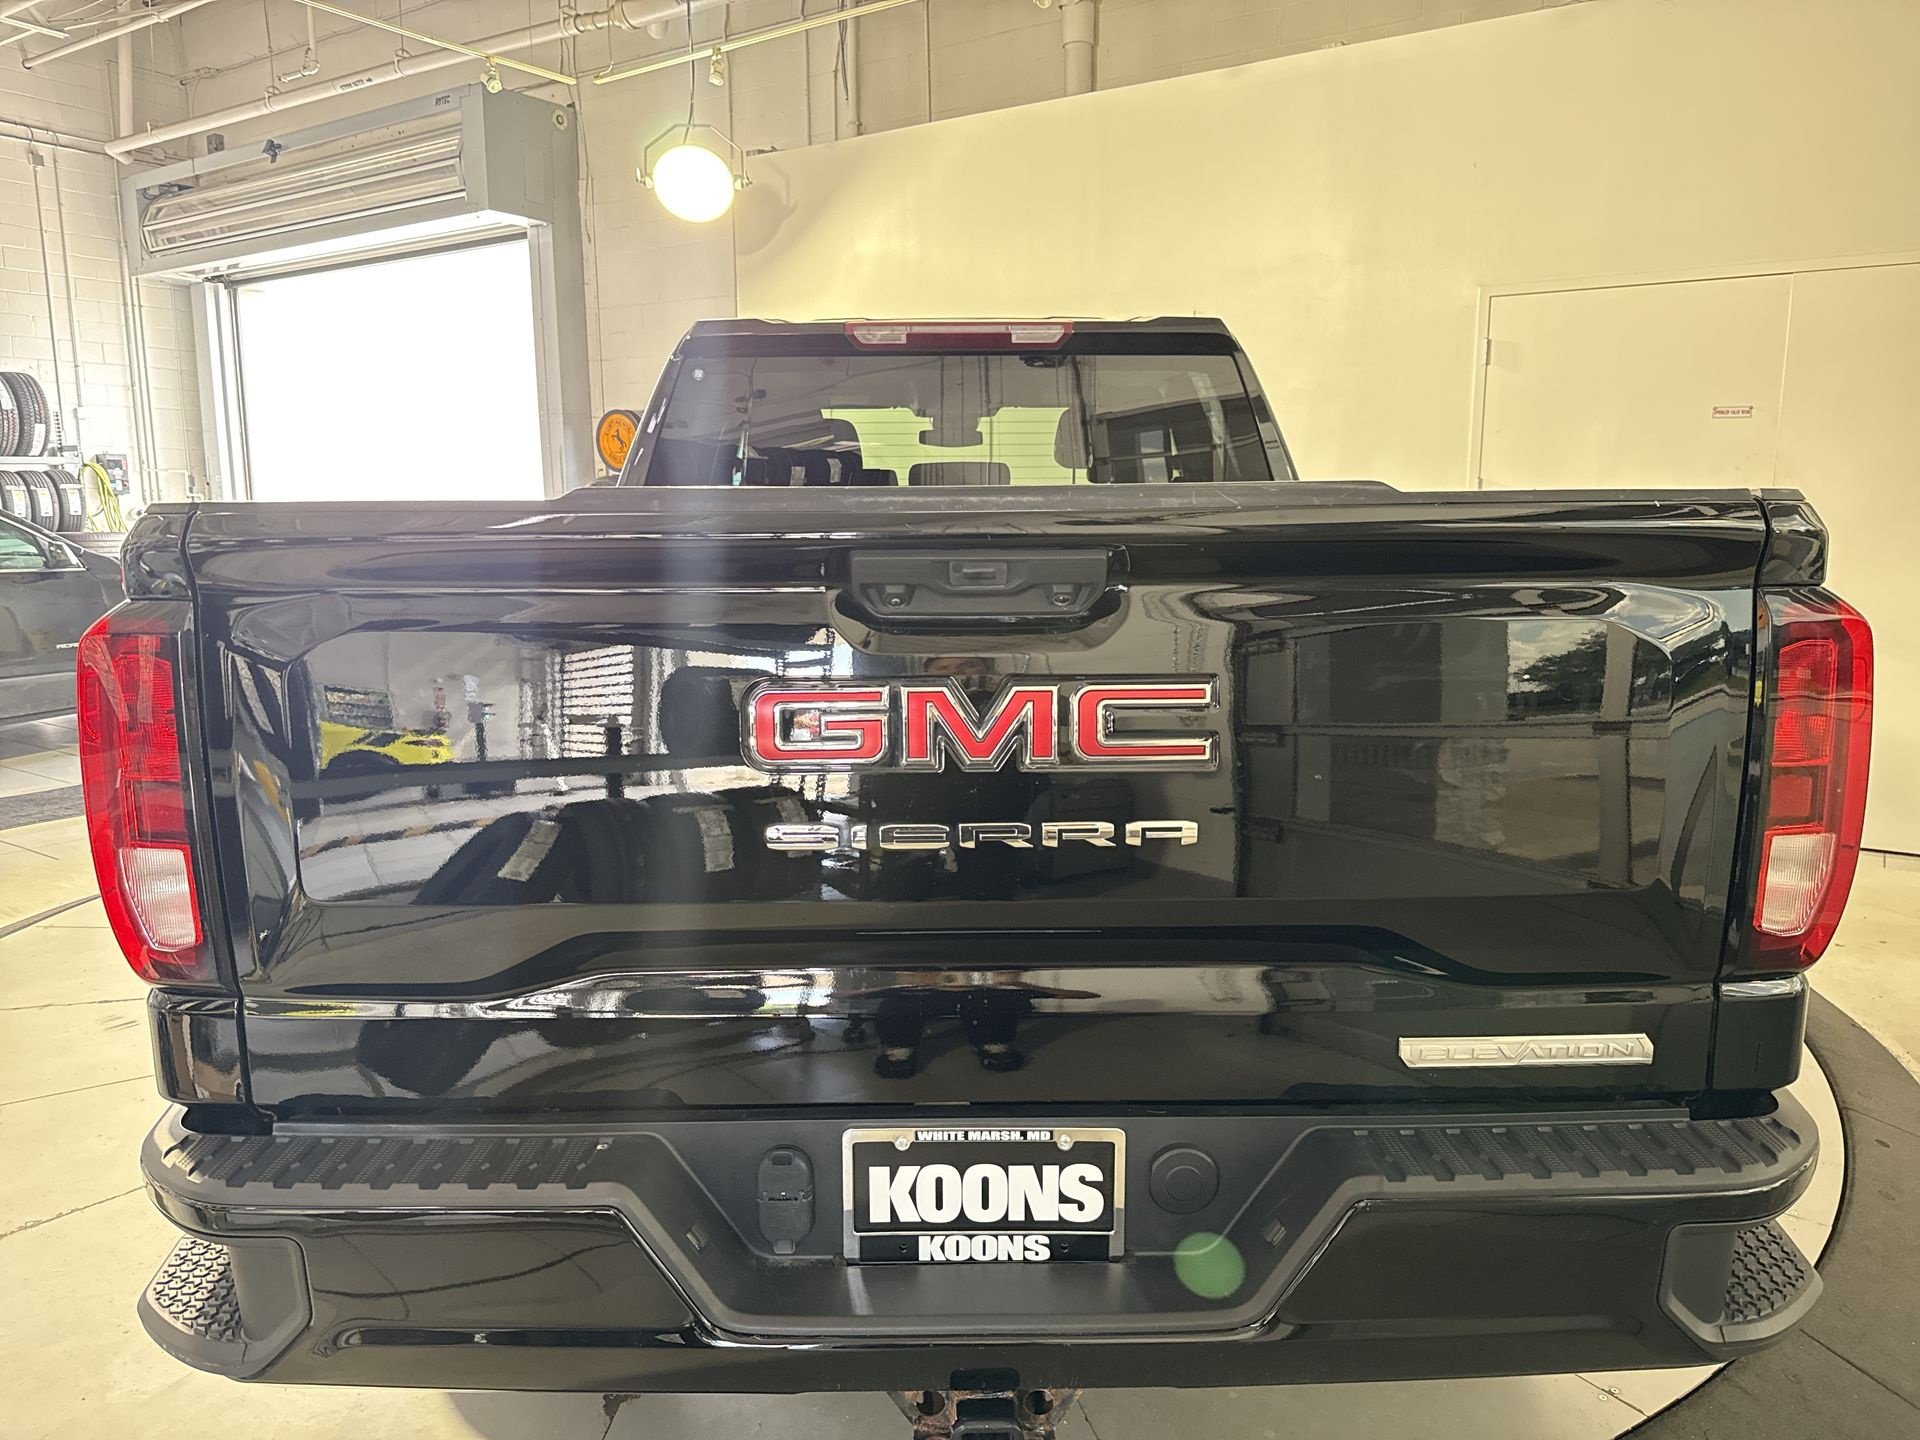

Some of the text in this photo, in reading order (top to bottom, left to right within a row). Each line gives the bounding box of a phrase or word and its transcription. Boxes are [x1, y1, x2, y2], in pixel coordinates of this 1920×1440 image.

[746, 677, 1218, 771] GMC
[764, 820, 1199, 851] SIERRA
[1418, 1041, 1635, 1061] ELEVATION
[916, 1130, 965, 1141] WHITE
[1027, 1130, 1051, 1141] MD
[868, 1163, 1105, 1224] KOONS
[918, 1235, 1051, 1262] KOONS
